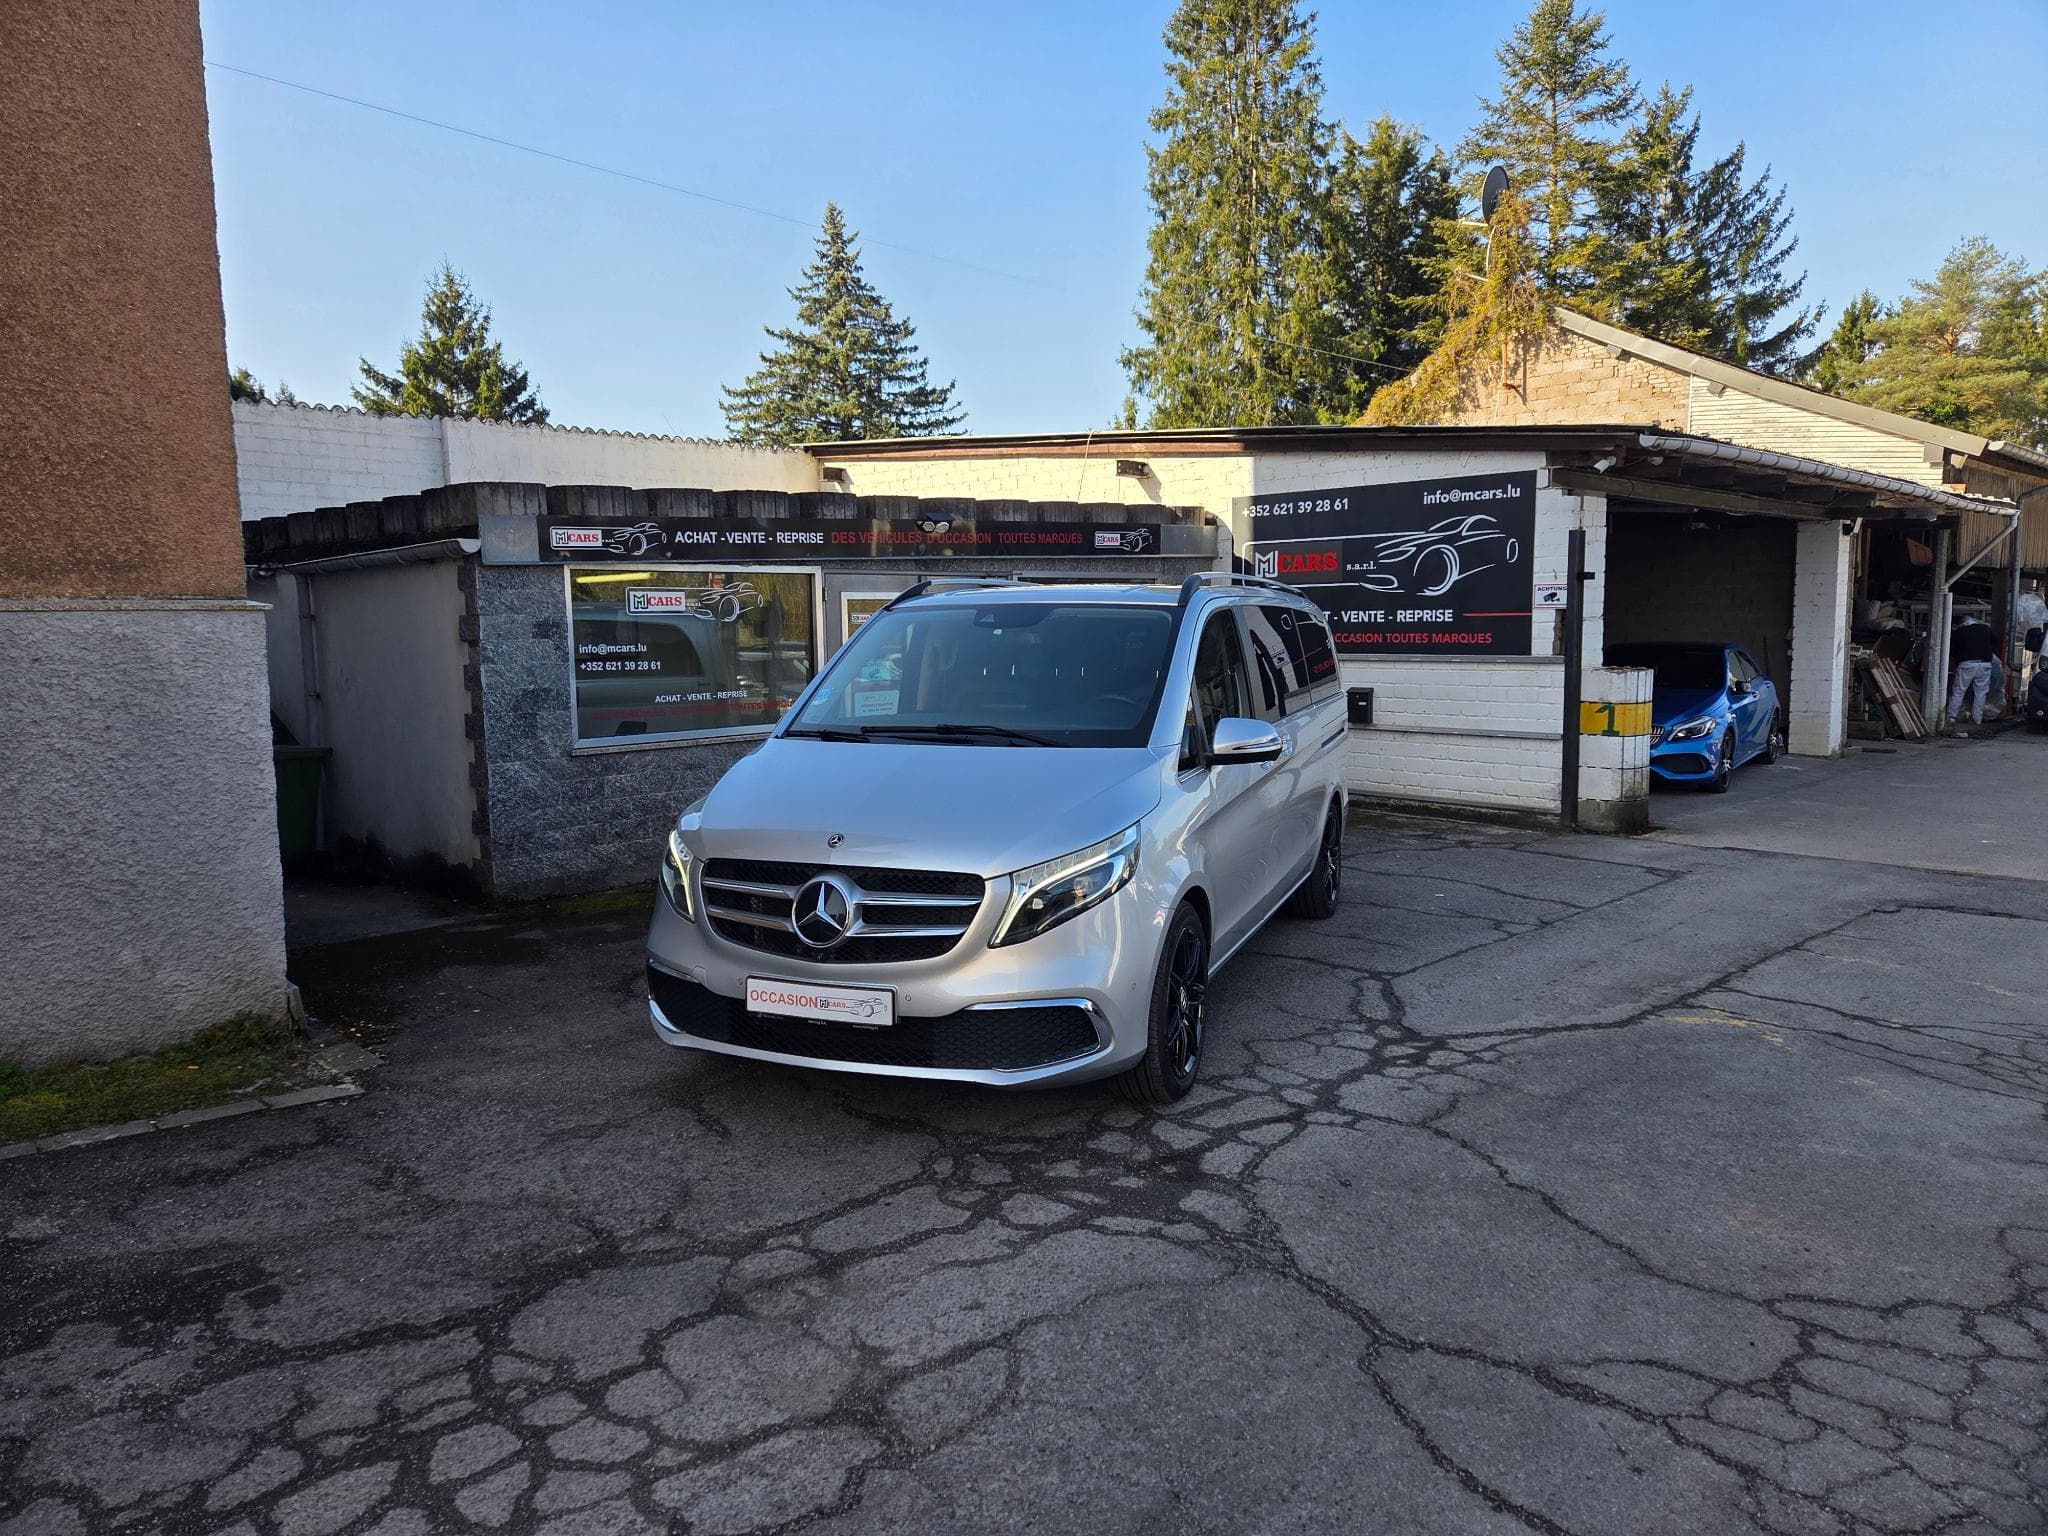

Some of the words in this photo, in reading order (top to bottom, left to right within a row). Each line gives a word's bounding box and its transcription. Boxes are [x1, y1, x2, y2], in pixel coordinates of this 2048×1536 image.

[1423, 484, 1521, 505] info@mcars.lu
[1242, 505, 1270, 518] +352
[1273, 503, 1294, 515] 621
[1297, 501, 1313, 513] 39
[1315, 499, 1331, 512] 28
[1333, 497, 1348, 511] 61
[674, 531, 717, 544] ACHAT
[776, 532, 824, 544] REPRISE
[831, 531, 856, 544] DES
[997, 532, 1036, 544] TOUTES
[1038, 532, 1084, 544] MARQUES
[1346, 561, 1377, 571] s.a.r.l.
[1341, 610, 1385, 622] VENTE
[1396, 609, 1454, 622] REPRISE
[1333, 633, 1383, 643] CCASION
[1385, 633, 1429, 643] TOUTES
[1431, 632, 1493, 644] MARQUES
[579, 643, 648, 655] info@mcars.lu
[580, 661, 604, 671] +352
[605, 661, 622, 670] 621
[624, 661, 636, 670] 39
[637, 661, 649, 670] 28
[650, 661, 661, 670] 61
[655, 694, 682, 703] ACHAT
[687, 692, 712, 701] VENTE
[717, 689, 748, 699] REPRISE
[1595, 703, 1620, 737] 1
[750, 989, 818, 1008] OCCASION
